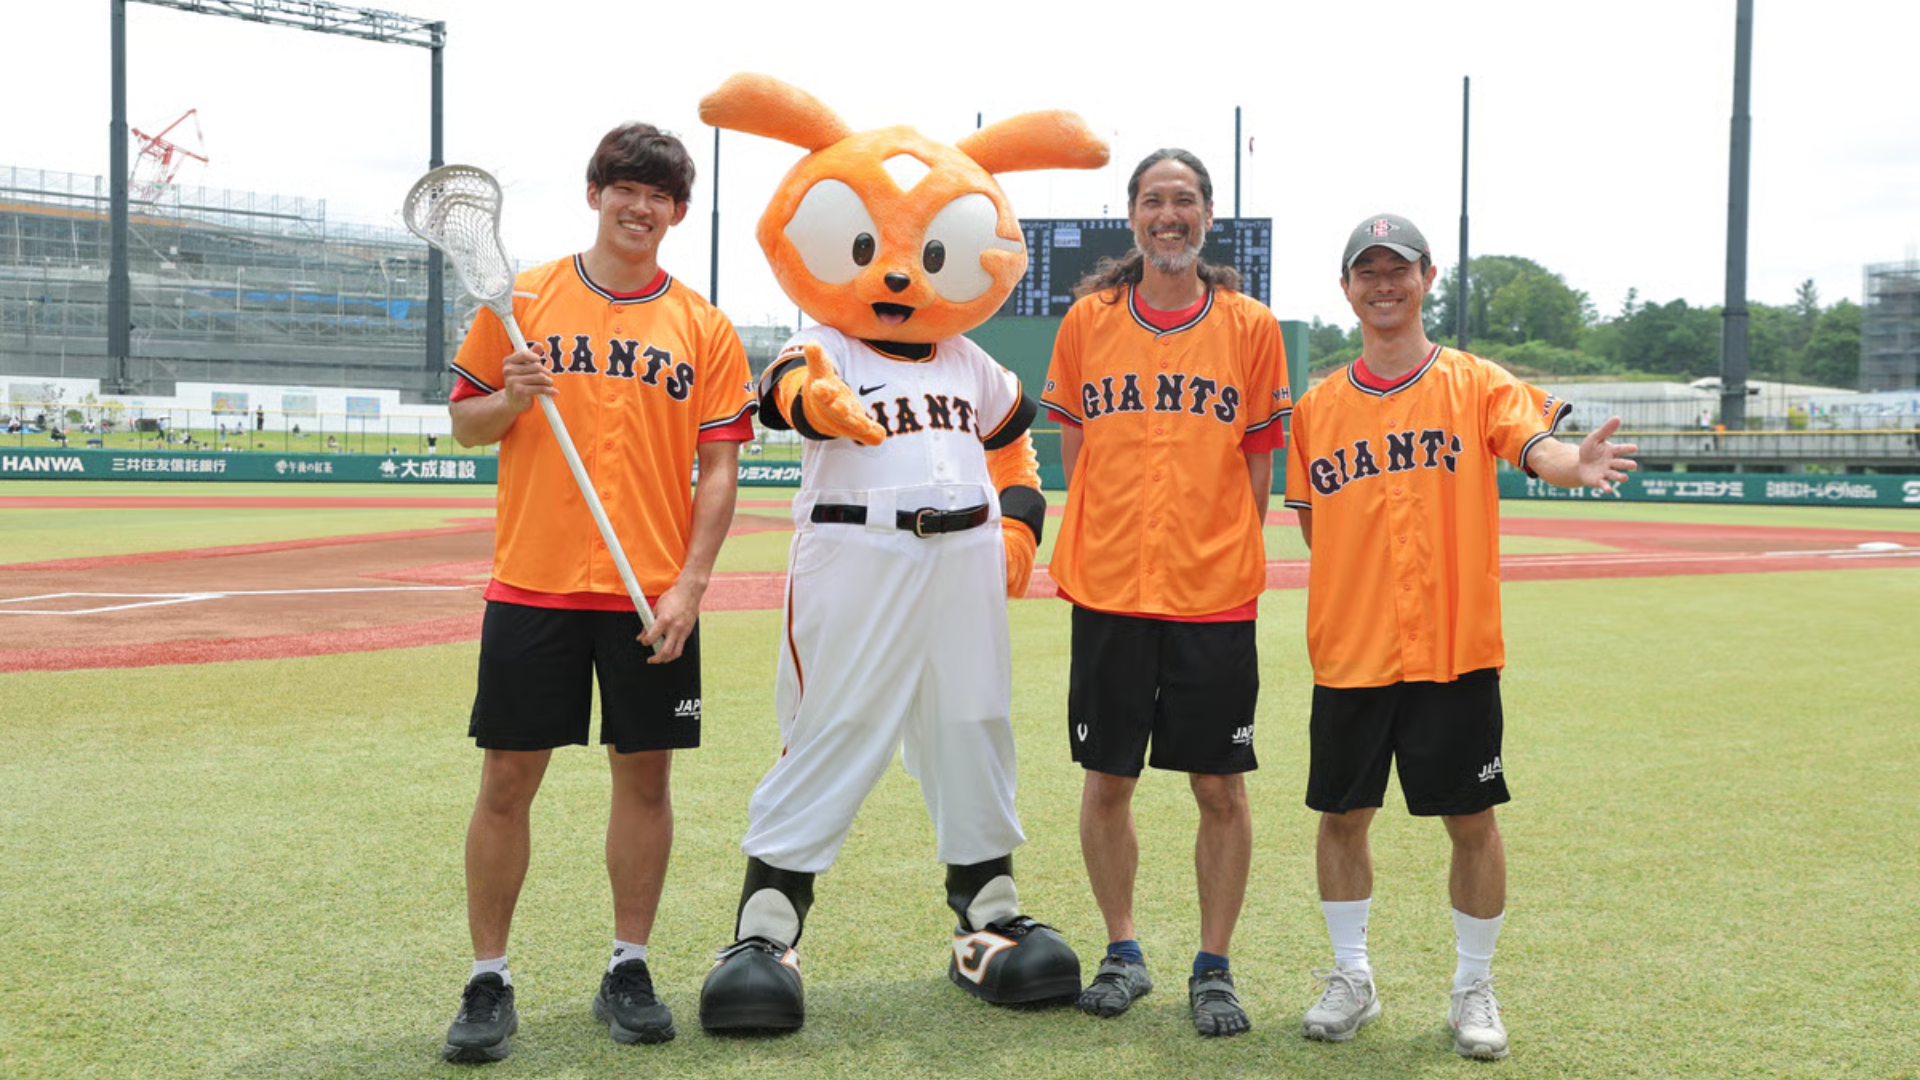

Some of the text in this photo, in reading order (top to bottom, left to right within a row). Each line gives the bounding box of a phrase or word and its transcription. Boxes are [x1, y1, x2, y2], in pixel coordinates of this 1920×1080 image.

[526, 335, 695, 401] IANTS
[1081, 373, 1239, 424] GIANTS
[853, 393, 985, 447] IANT
[2, 455, 85, 472] HANWA
[111, 457, 227, 473] 三井住友信託銀行
[400, 459, 476, 479] 大成建設
[1674, 481, 1744, 497] エコミナミ
